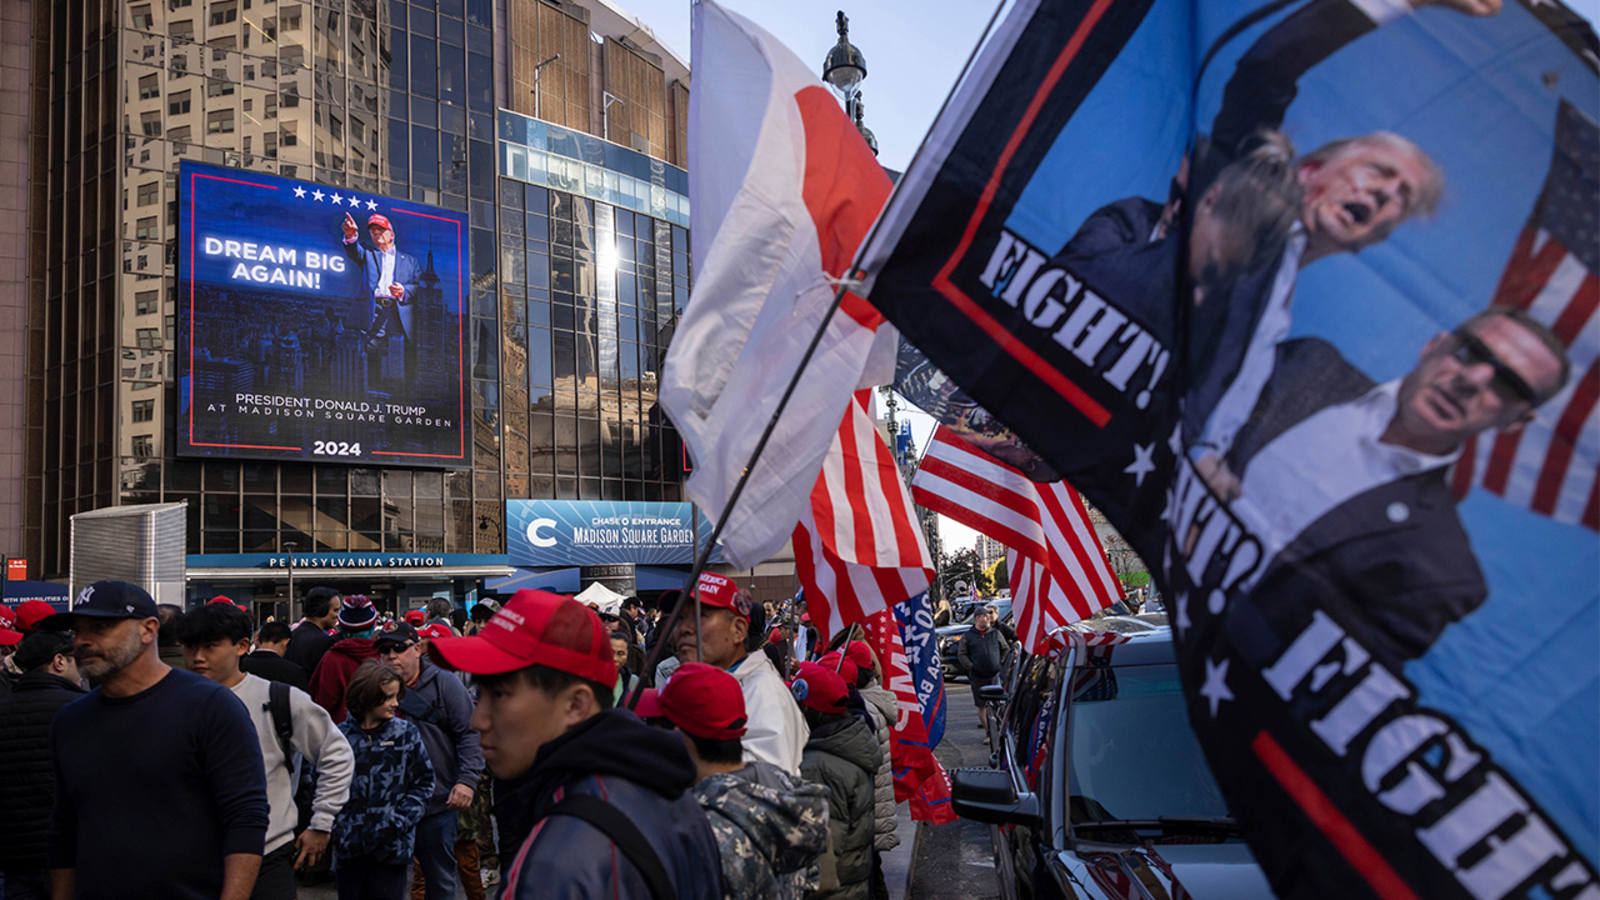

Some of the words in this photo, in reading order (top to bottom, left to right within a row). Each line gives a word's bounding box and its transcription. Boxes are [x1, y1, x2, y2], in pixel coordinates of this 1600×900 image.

[204, 237, 297, 266] DREAM
[305, 252, 346, 272] BIG
[232, 263, 321, 289] AGAIN!
[978, 230, 1171, 411] FIGHT!
[235, 393, 311, 408] PRESIDENT
[315, 399, 370, 413] DONALD
[373, 403, 383, 414] J.
[385, 404, 426, 416] TRUMP
[207, 404, 226, 413] AT
[238, 406, 316, 418] MADISON
[325, 411, 385, 423] SQUARE
[395, 416, 452, 427] GARDEN
[313, 440, 362, 457] 2024
[591, 517, 620, 526] CHASE
[632, 518, 681, 526] ENTRANCE
[526, 518, 558, 547] C
[573, 527, 619, 543] MADISON
[621, 527, 658, 544] SQUARE
[269, 557, 383, 567] PENNSYLVANIA
[389, 557, 444, 566] STATION
[699, 573, 727, 586] MERICA
[699, 583, 719, 594] GAIN
